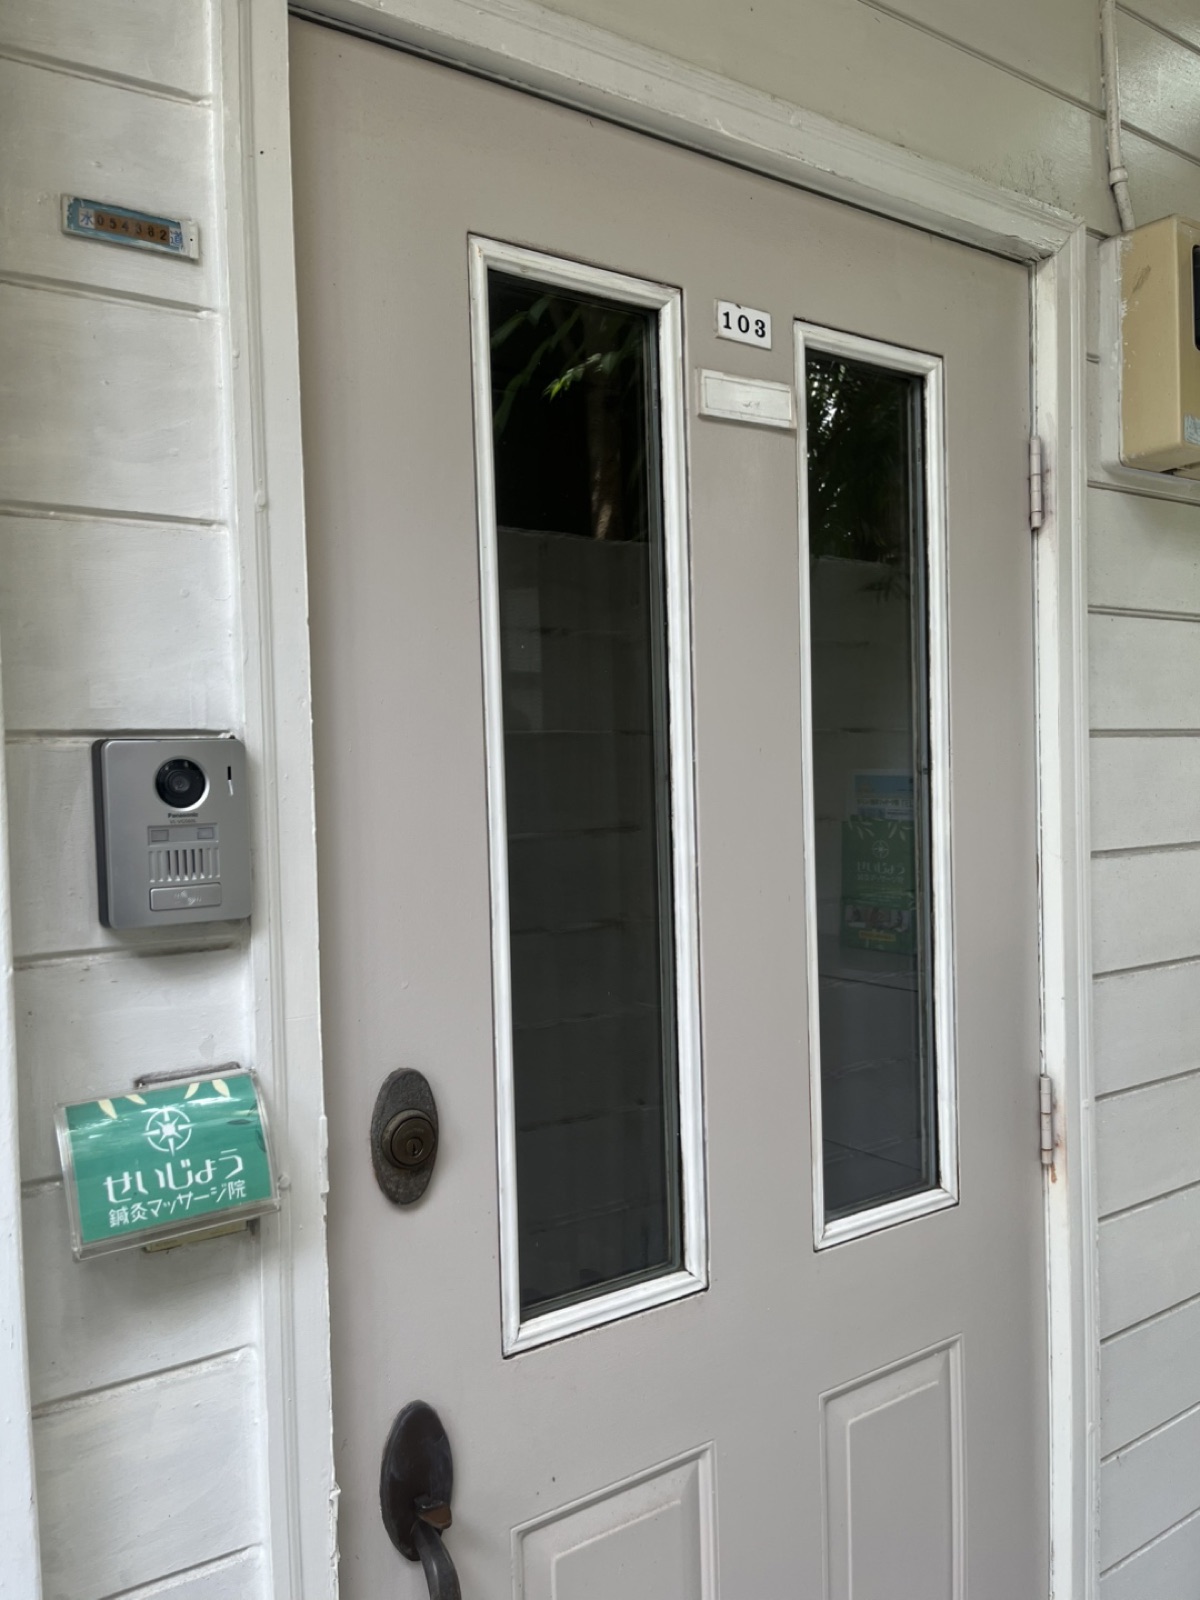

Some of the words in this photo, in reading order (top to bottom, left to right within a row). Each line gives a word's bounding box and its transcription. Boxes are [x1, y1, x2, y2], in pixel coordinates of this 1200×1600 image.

[723, 311, 766, 338] 103
[102, 1148, 244, 1203] せいじょう
[108, 1179, 247, 1228] 鍼灸マッサージ院
